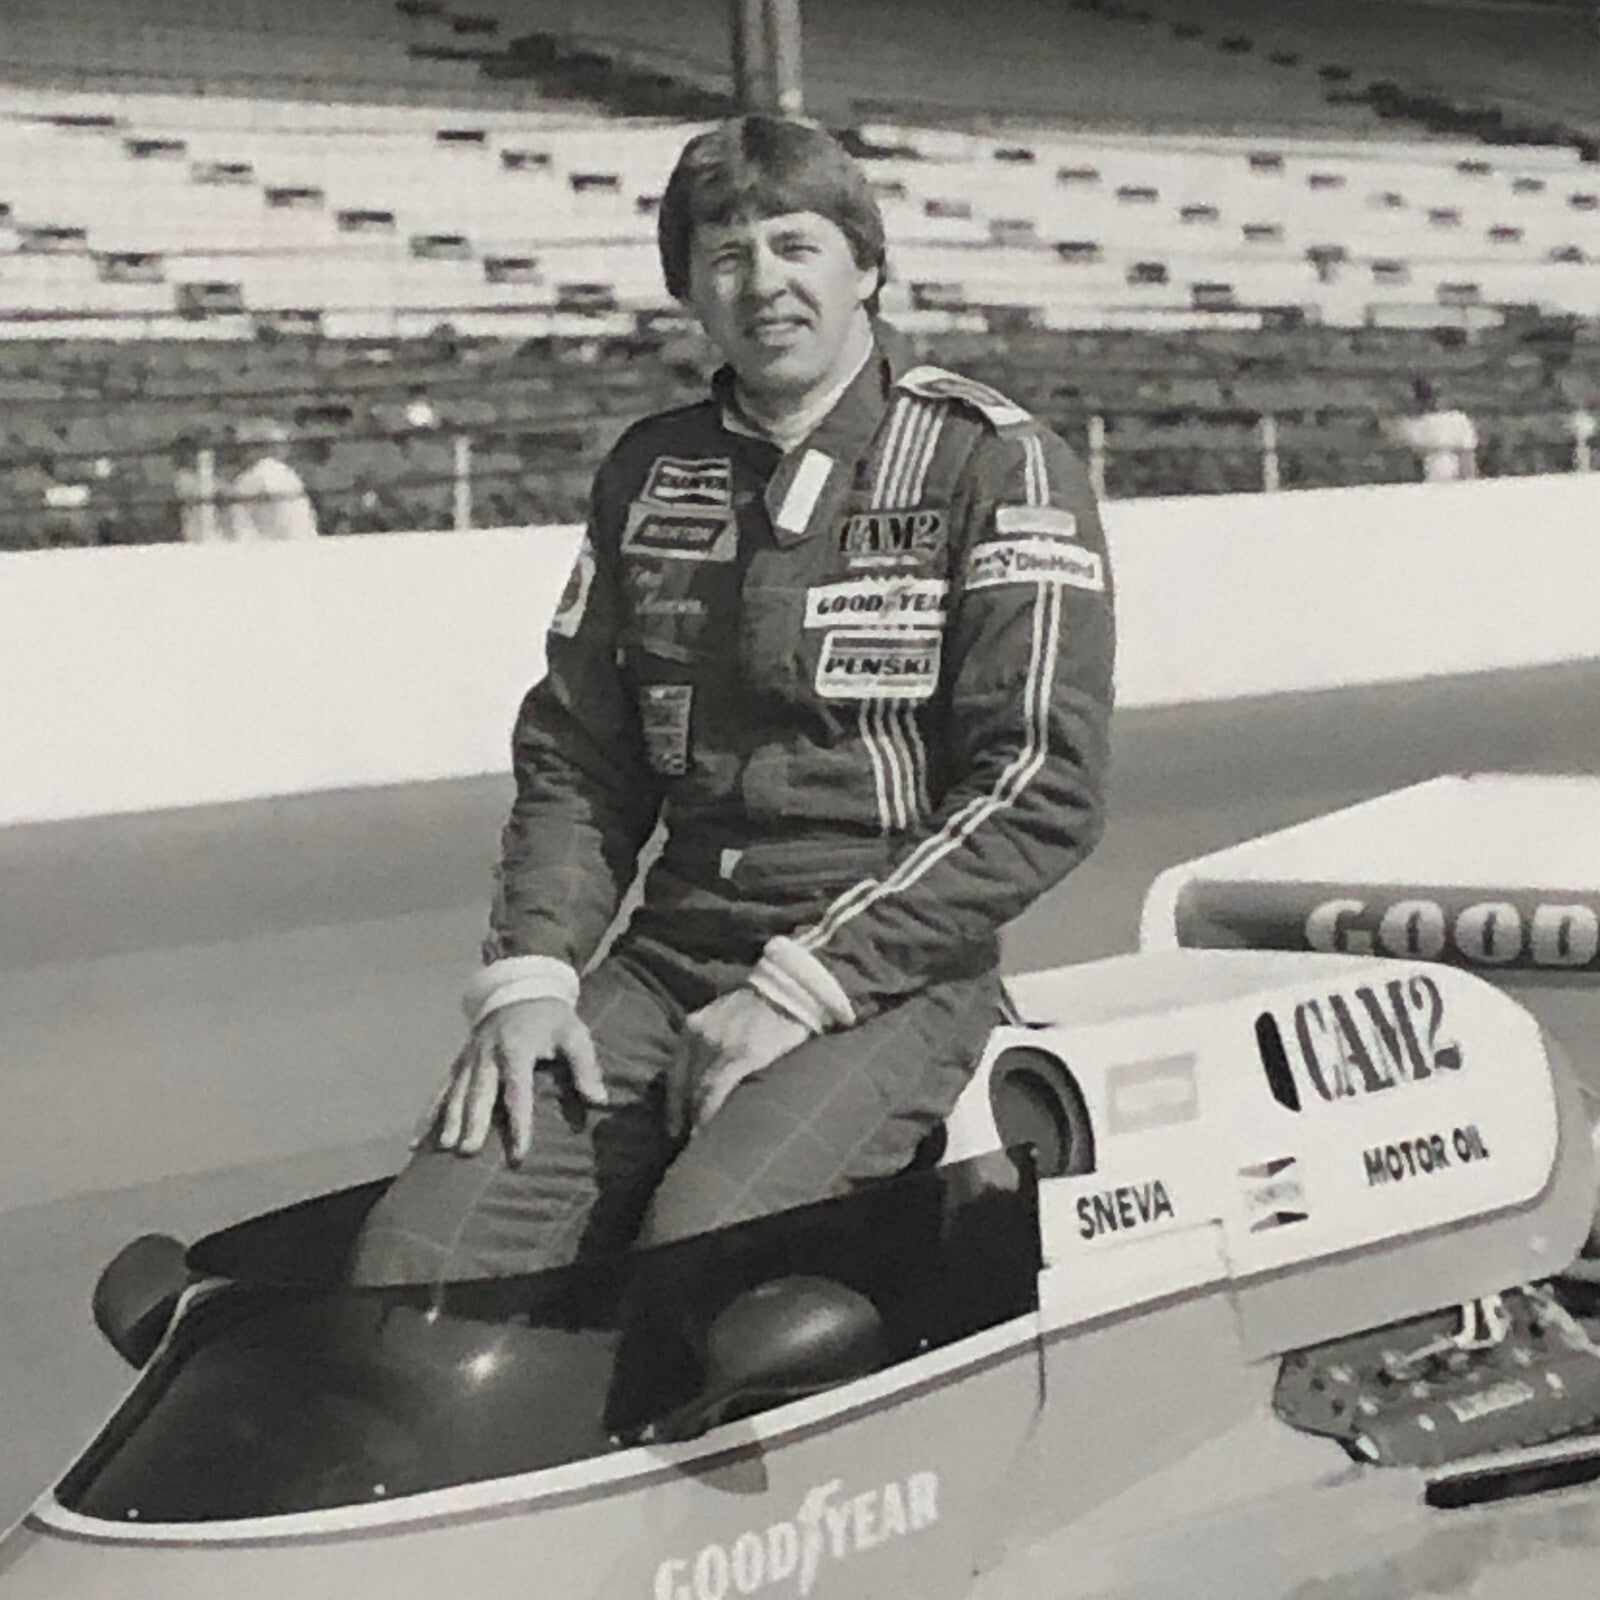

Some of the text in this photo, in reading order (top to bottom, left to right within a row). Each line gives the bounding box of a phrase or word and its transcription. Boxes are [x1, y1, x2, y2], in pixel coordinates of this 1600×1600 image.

[839, 511, 940, 551] CAM2
[1294, 974, 1462, 1101] CAM2
[1363, 1125, 1490, 1186] MOTOR OIL
[1077, 1180, 1175, 1240] SNEVA
[654, 1471, 939, 1600] GOODYEAR
